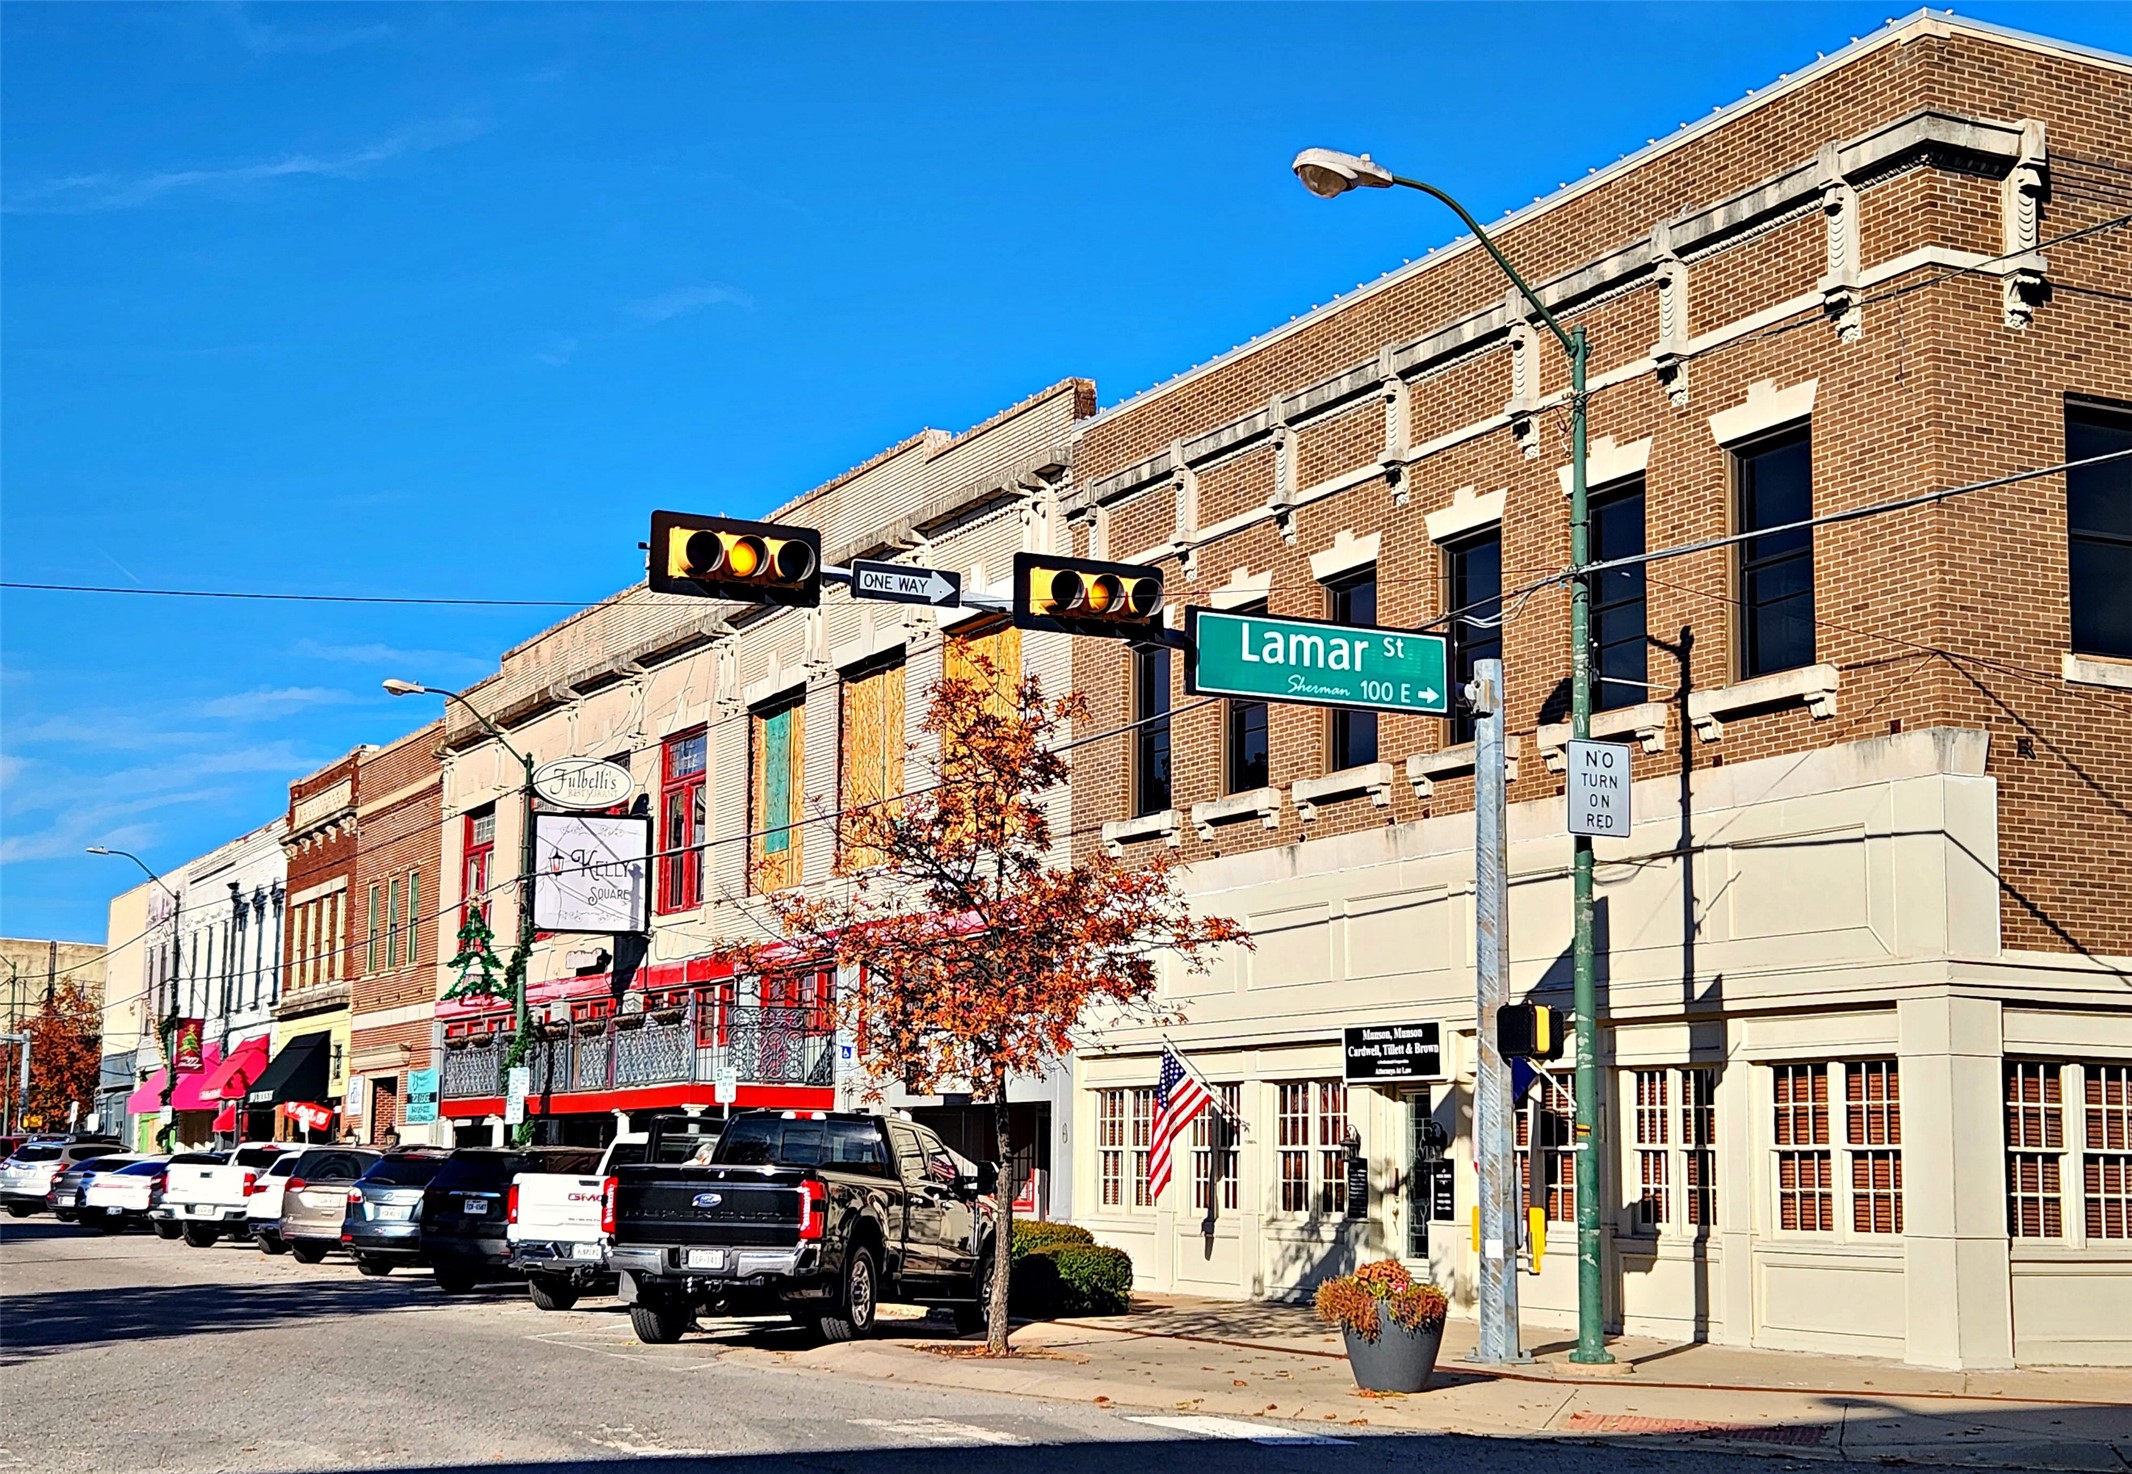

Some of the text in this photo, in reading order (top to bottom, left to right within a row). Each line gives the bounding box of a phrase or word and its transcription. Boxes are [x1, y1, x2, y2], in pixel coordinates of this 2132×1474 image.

[864, 573, 928, 594] ONE WAY
[1241, 622, 1405, 672] Lamar St
[1287, 674, 1412, 704] Sherman 100 E
[1586, 750, 1614, 769] NO
[550, 768, 617, 795] Fulbelli's
[1581, 773, 1618, 789] TURN
[1589, 793, 1610, 809] ON
[1586, 813, 1614, 829] RED
[588, 886, 630, 906] SQUARE
[1362, 1027, 1423, 1041] Munson, Munson
[1348, 1042, 1439, 1057] Cardwell, Tillett & Brown
[568, 1193, 602, 1202] GMC
